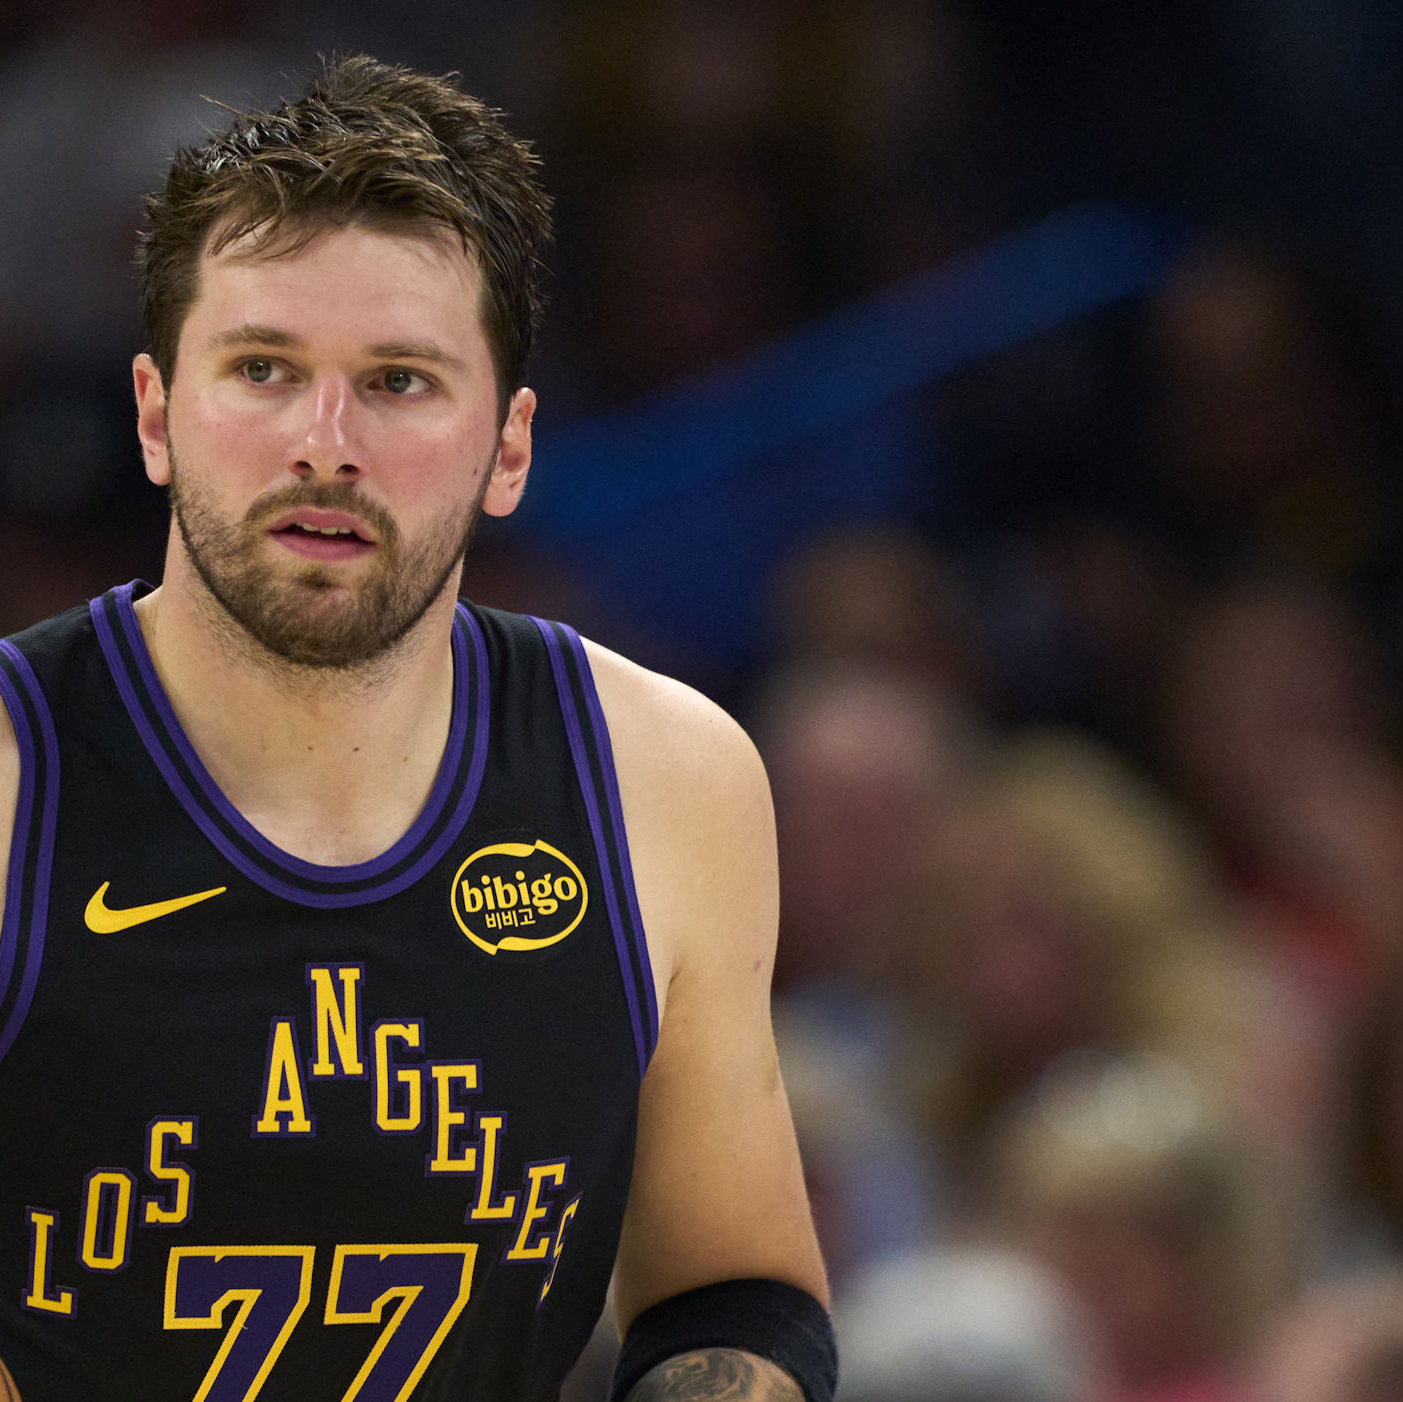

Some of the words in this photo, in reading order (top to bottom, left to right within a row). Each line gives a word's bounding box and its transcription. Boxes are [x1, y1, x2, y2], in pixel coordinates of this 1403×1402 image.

[460, 870, 579, 916] bibigo
[484, 907, 537, 930] 비비고
[22, 1116, 197, 1317] LOS
[253, 962, 582, 1307] ANGELES
